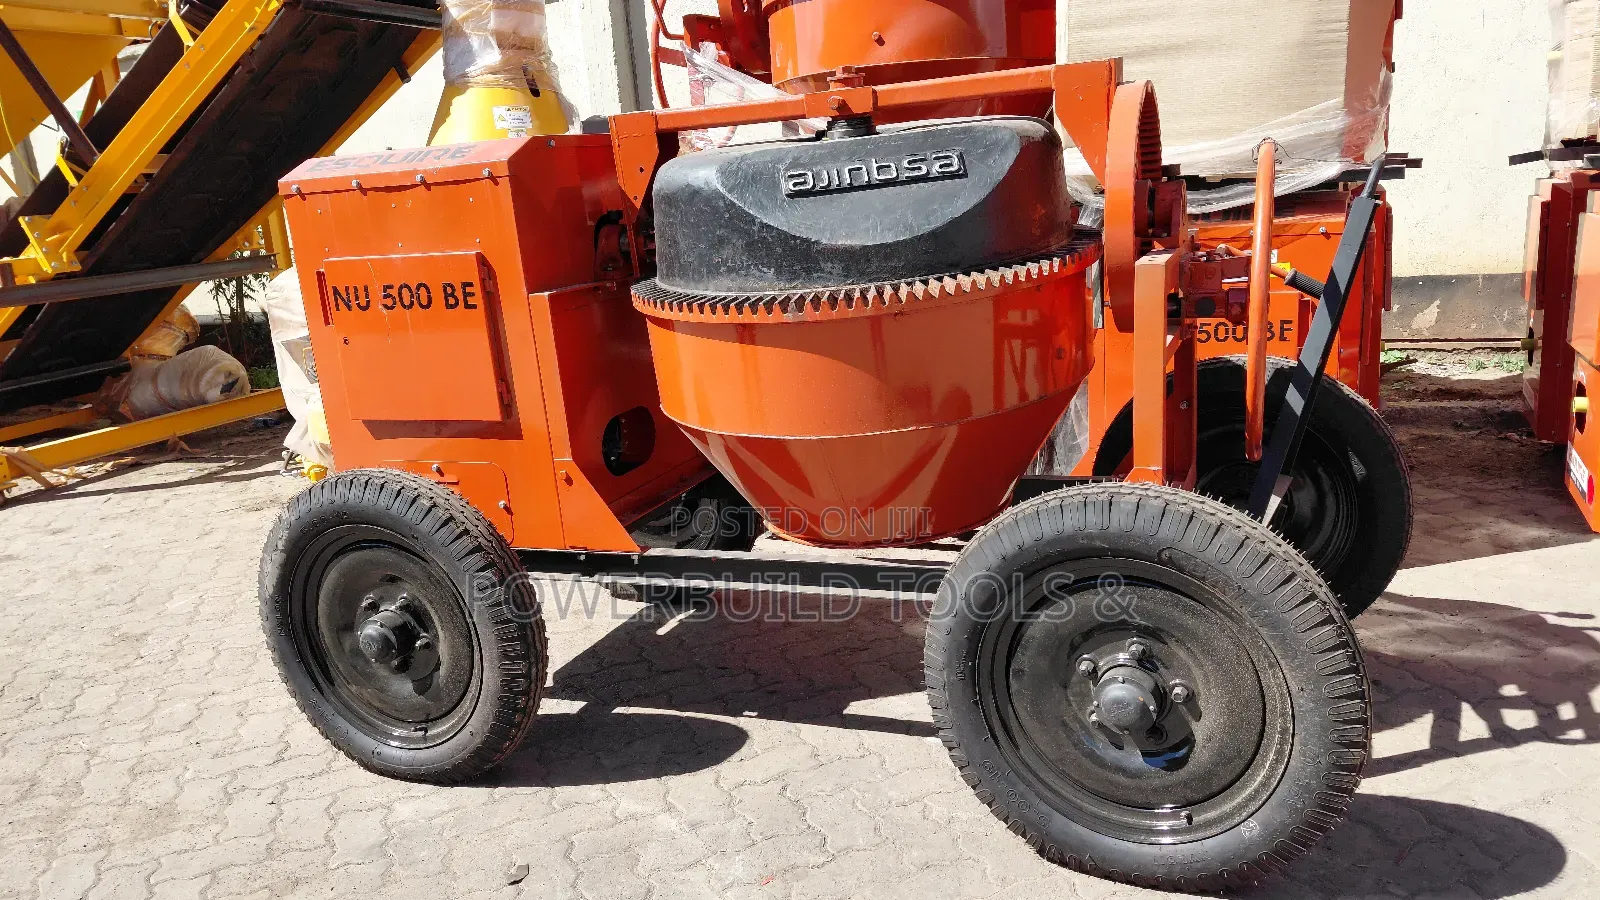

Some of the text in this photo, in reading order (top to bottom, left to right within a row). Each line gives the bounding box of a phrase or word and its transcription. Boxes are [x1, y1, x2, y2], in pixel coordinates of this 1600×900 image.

[305, 144, 477, 173] ESQUIRE
[332, 281, 478, 311] NU 500 BE
[1197, 321, 1247, 343] 500
